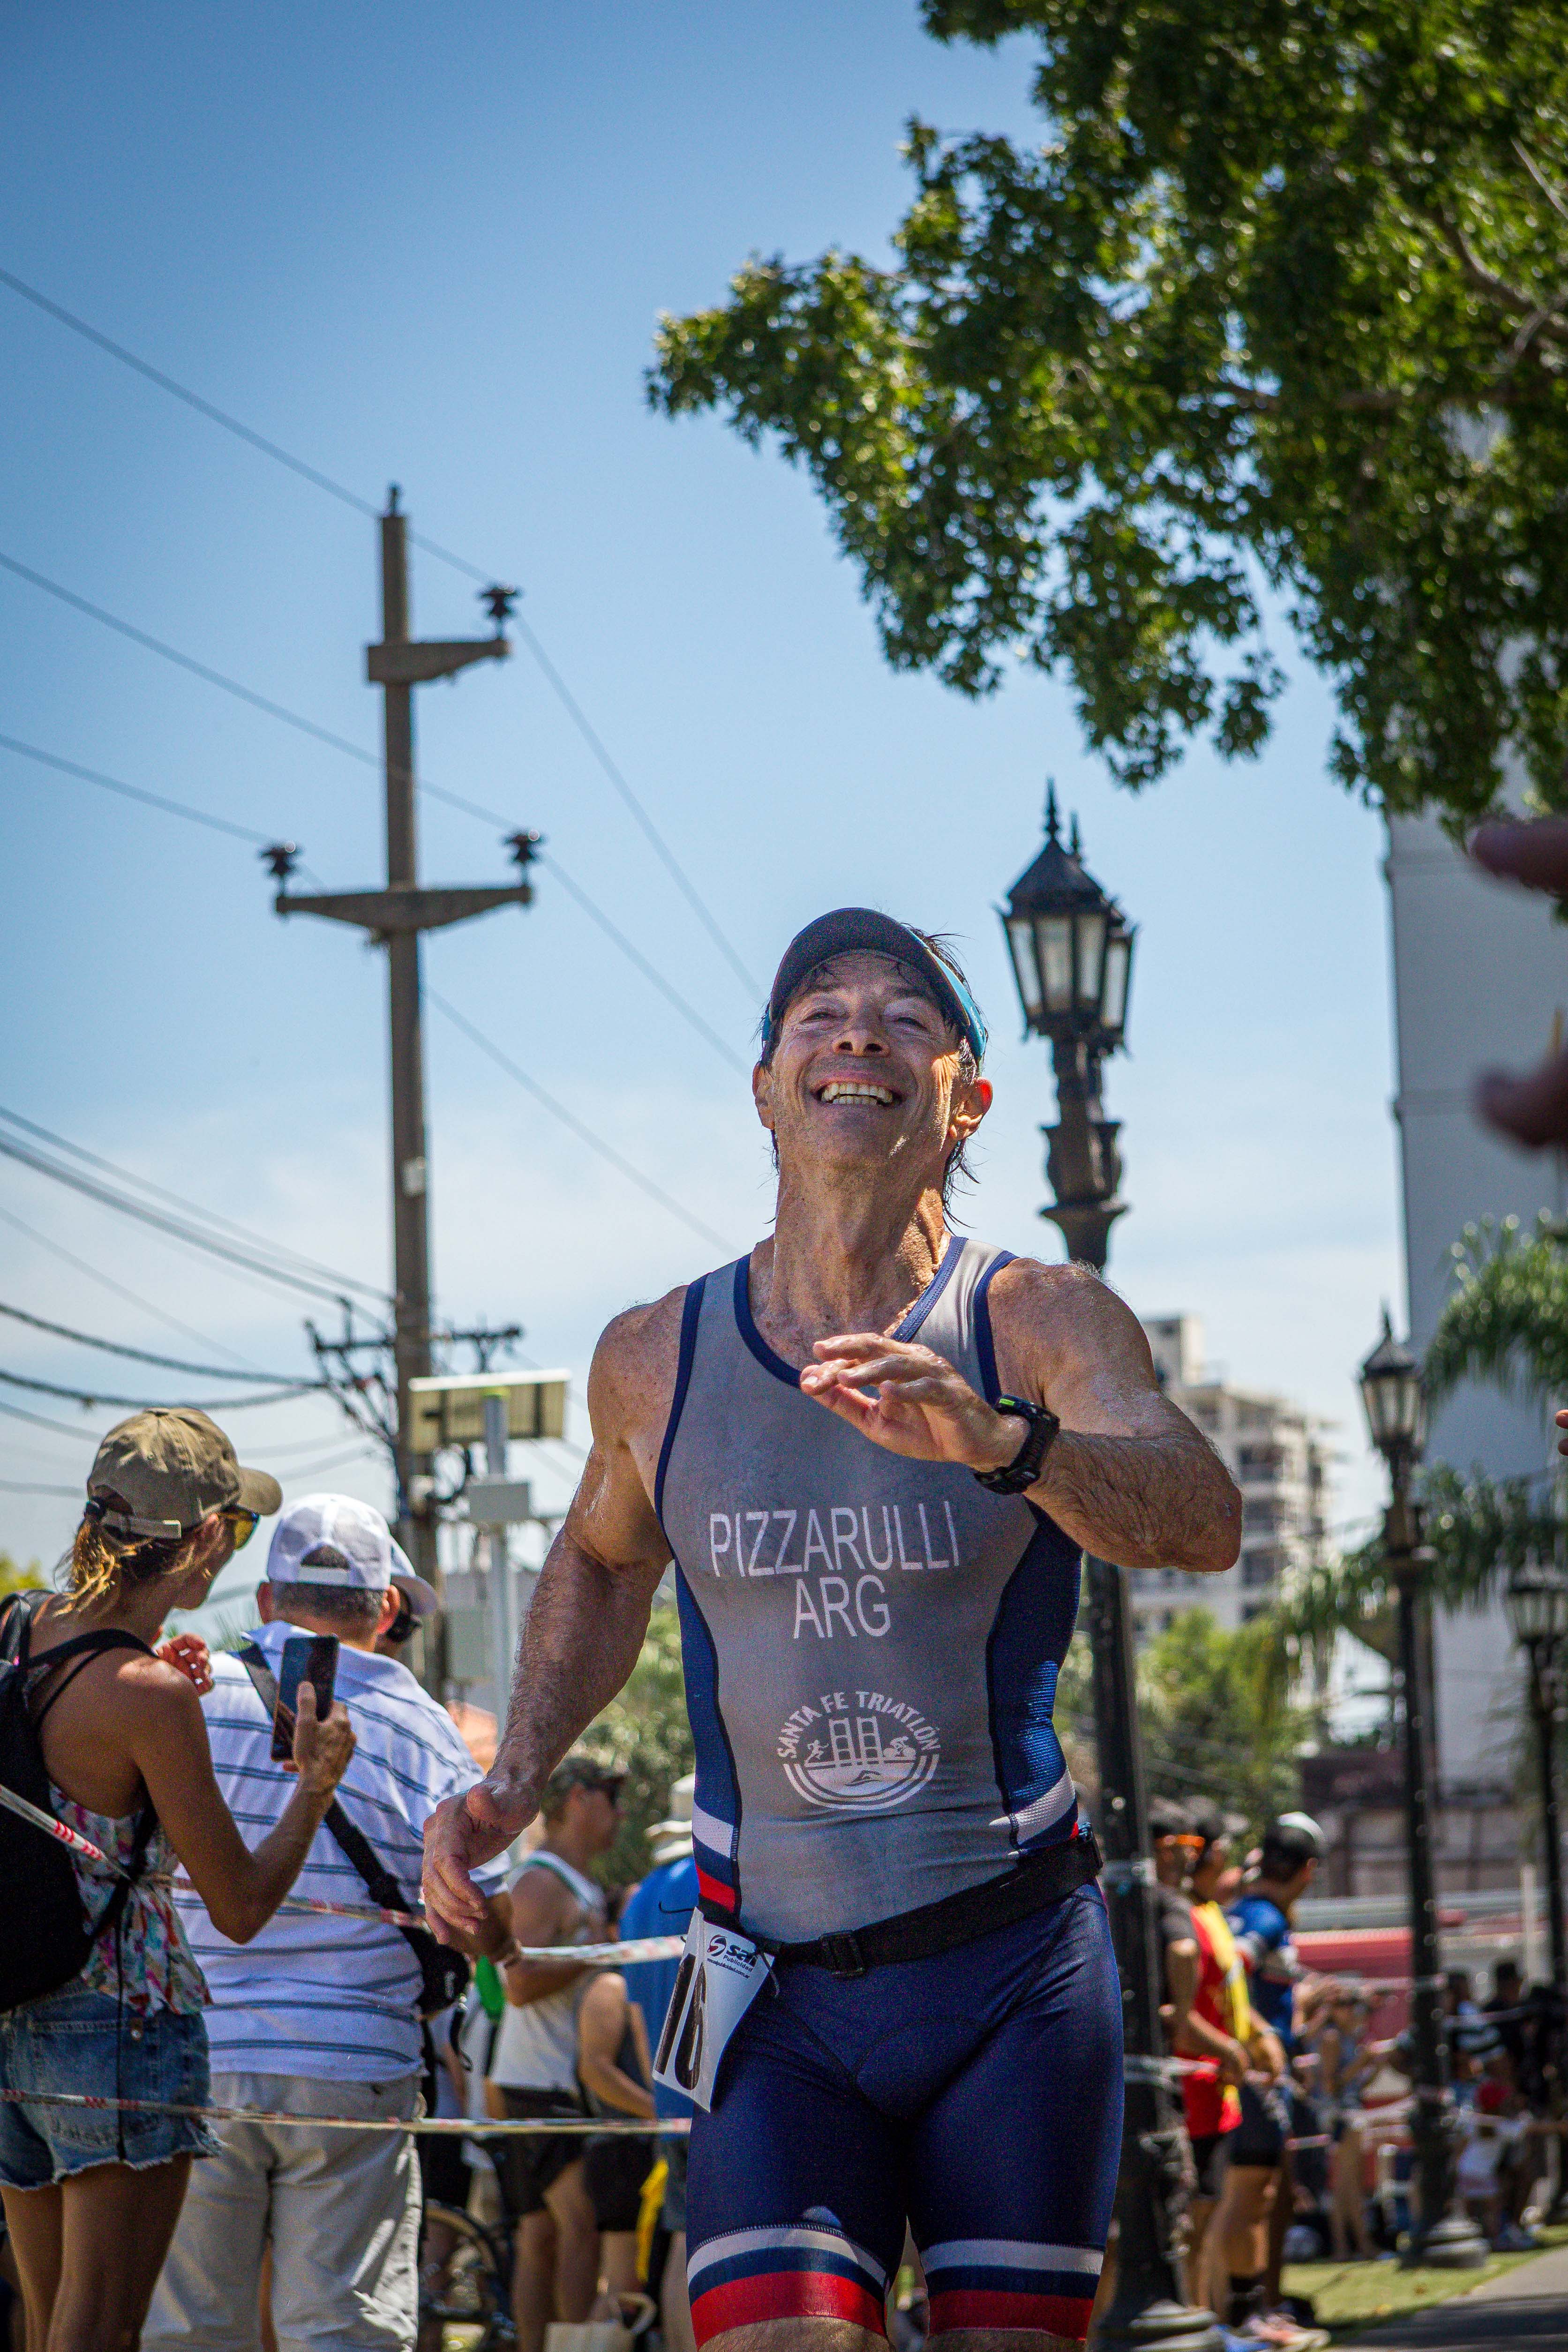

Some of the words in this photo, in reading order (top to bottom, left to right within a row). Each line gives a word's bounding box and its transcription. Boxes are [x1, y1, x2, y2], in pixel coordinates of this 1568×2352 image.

[709, 1501, 960, 1577] PIZZARULLI
[793, 1574, 891, 1639] ARG
[776, 1705, 822, 1759] SANTA
[820, 1692, 849, 1714] FE
[722, 1954, 754, 1972] Publicidad
